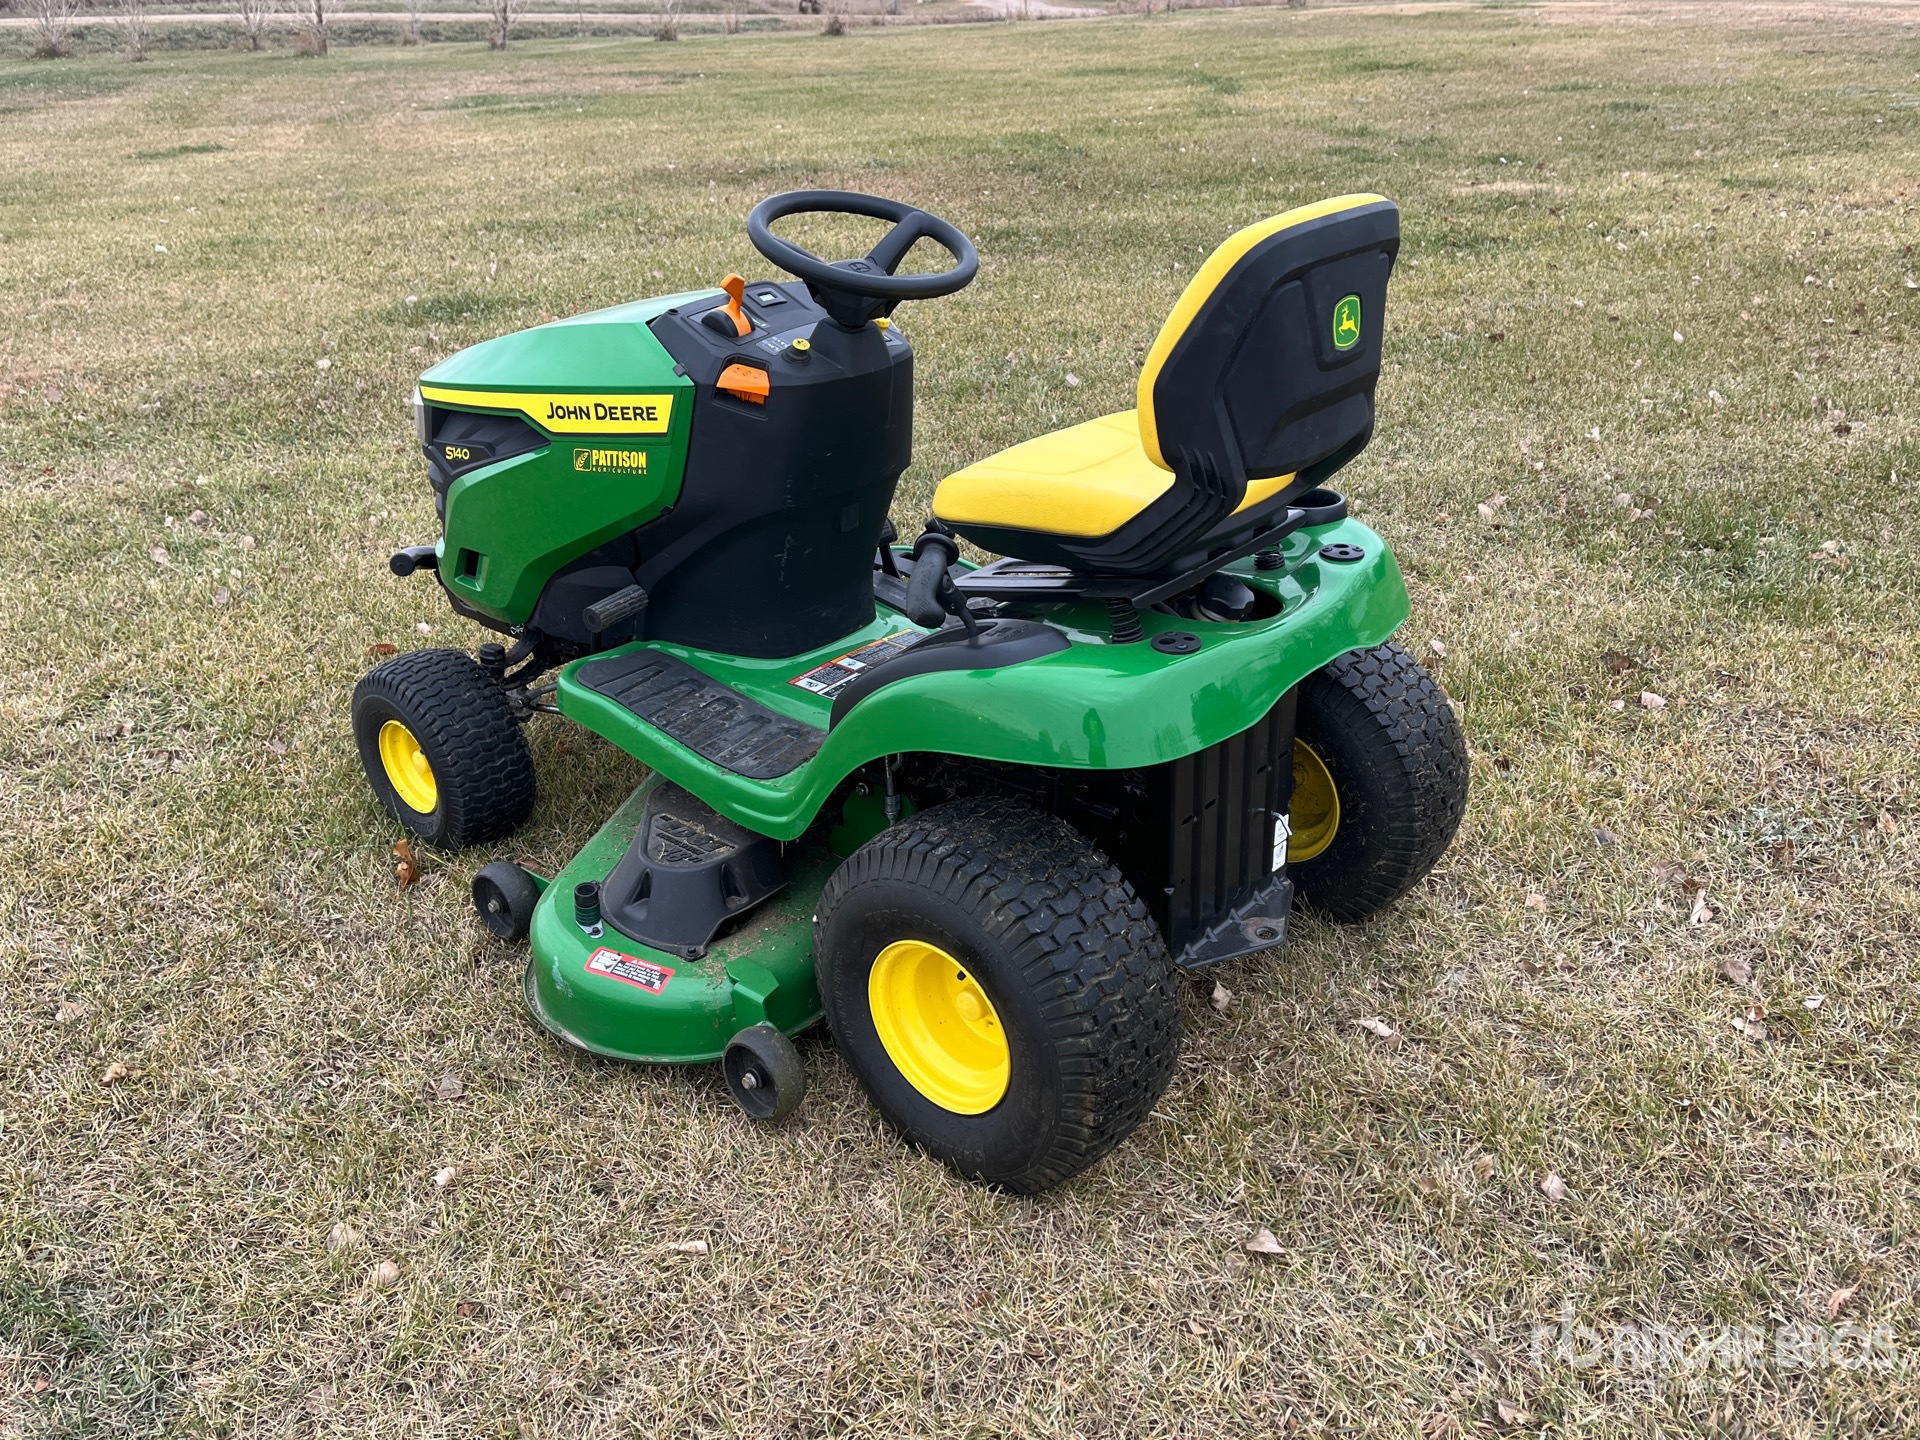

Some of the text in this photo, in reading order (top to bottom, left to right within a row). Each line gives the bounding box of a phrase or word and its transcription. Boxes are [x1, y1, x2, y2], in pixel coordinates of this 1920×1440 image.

[546, 401, 658, 421] JOHN DEERE
[445, 446, 470, 460] S140
[592, 449, 646, 468] PATTISON
[593, 467, 647, 475] AGRICULTURE
